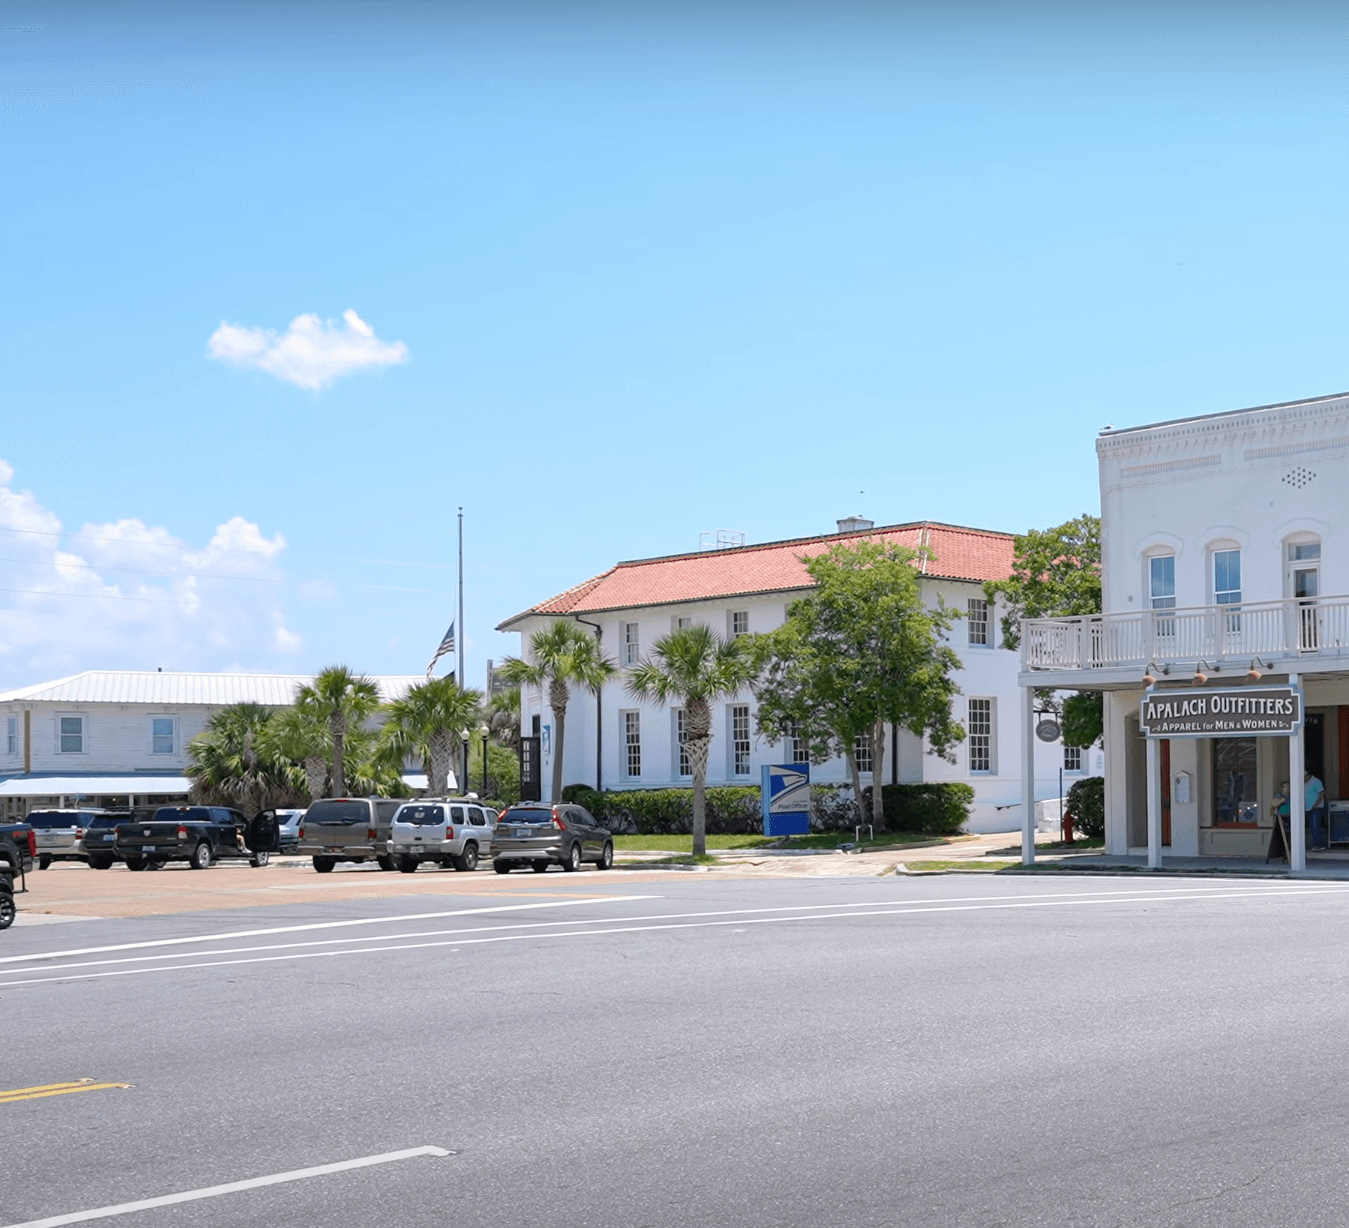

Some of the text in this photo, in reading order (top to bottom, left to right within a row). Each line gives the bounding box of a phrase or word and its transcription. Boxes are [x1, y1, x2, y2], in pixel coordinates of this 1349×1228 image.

[1147, 695, 1293, 719] APALACH OUTFITTERS
[1162, 722, 1200, 731] APPAREL
[1215, 720, 1234, 730] MEN
[1242, 719, 1277, 729] WOMEN
